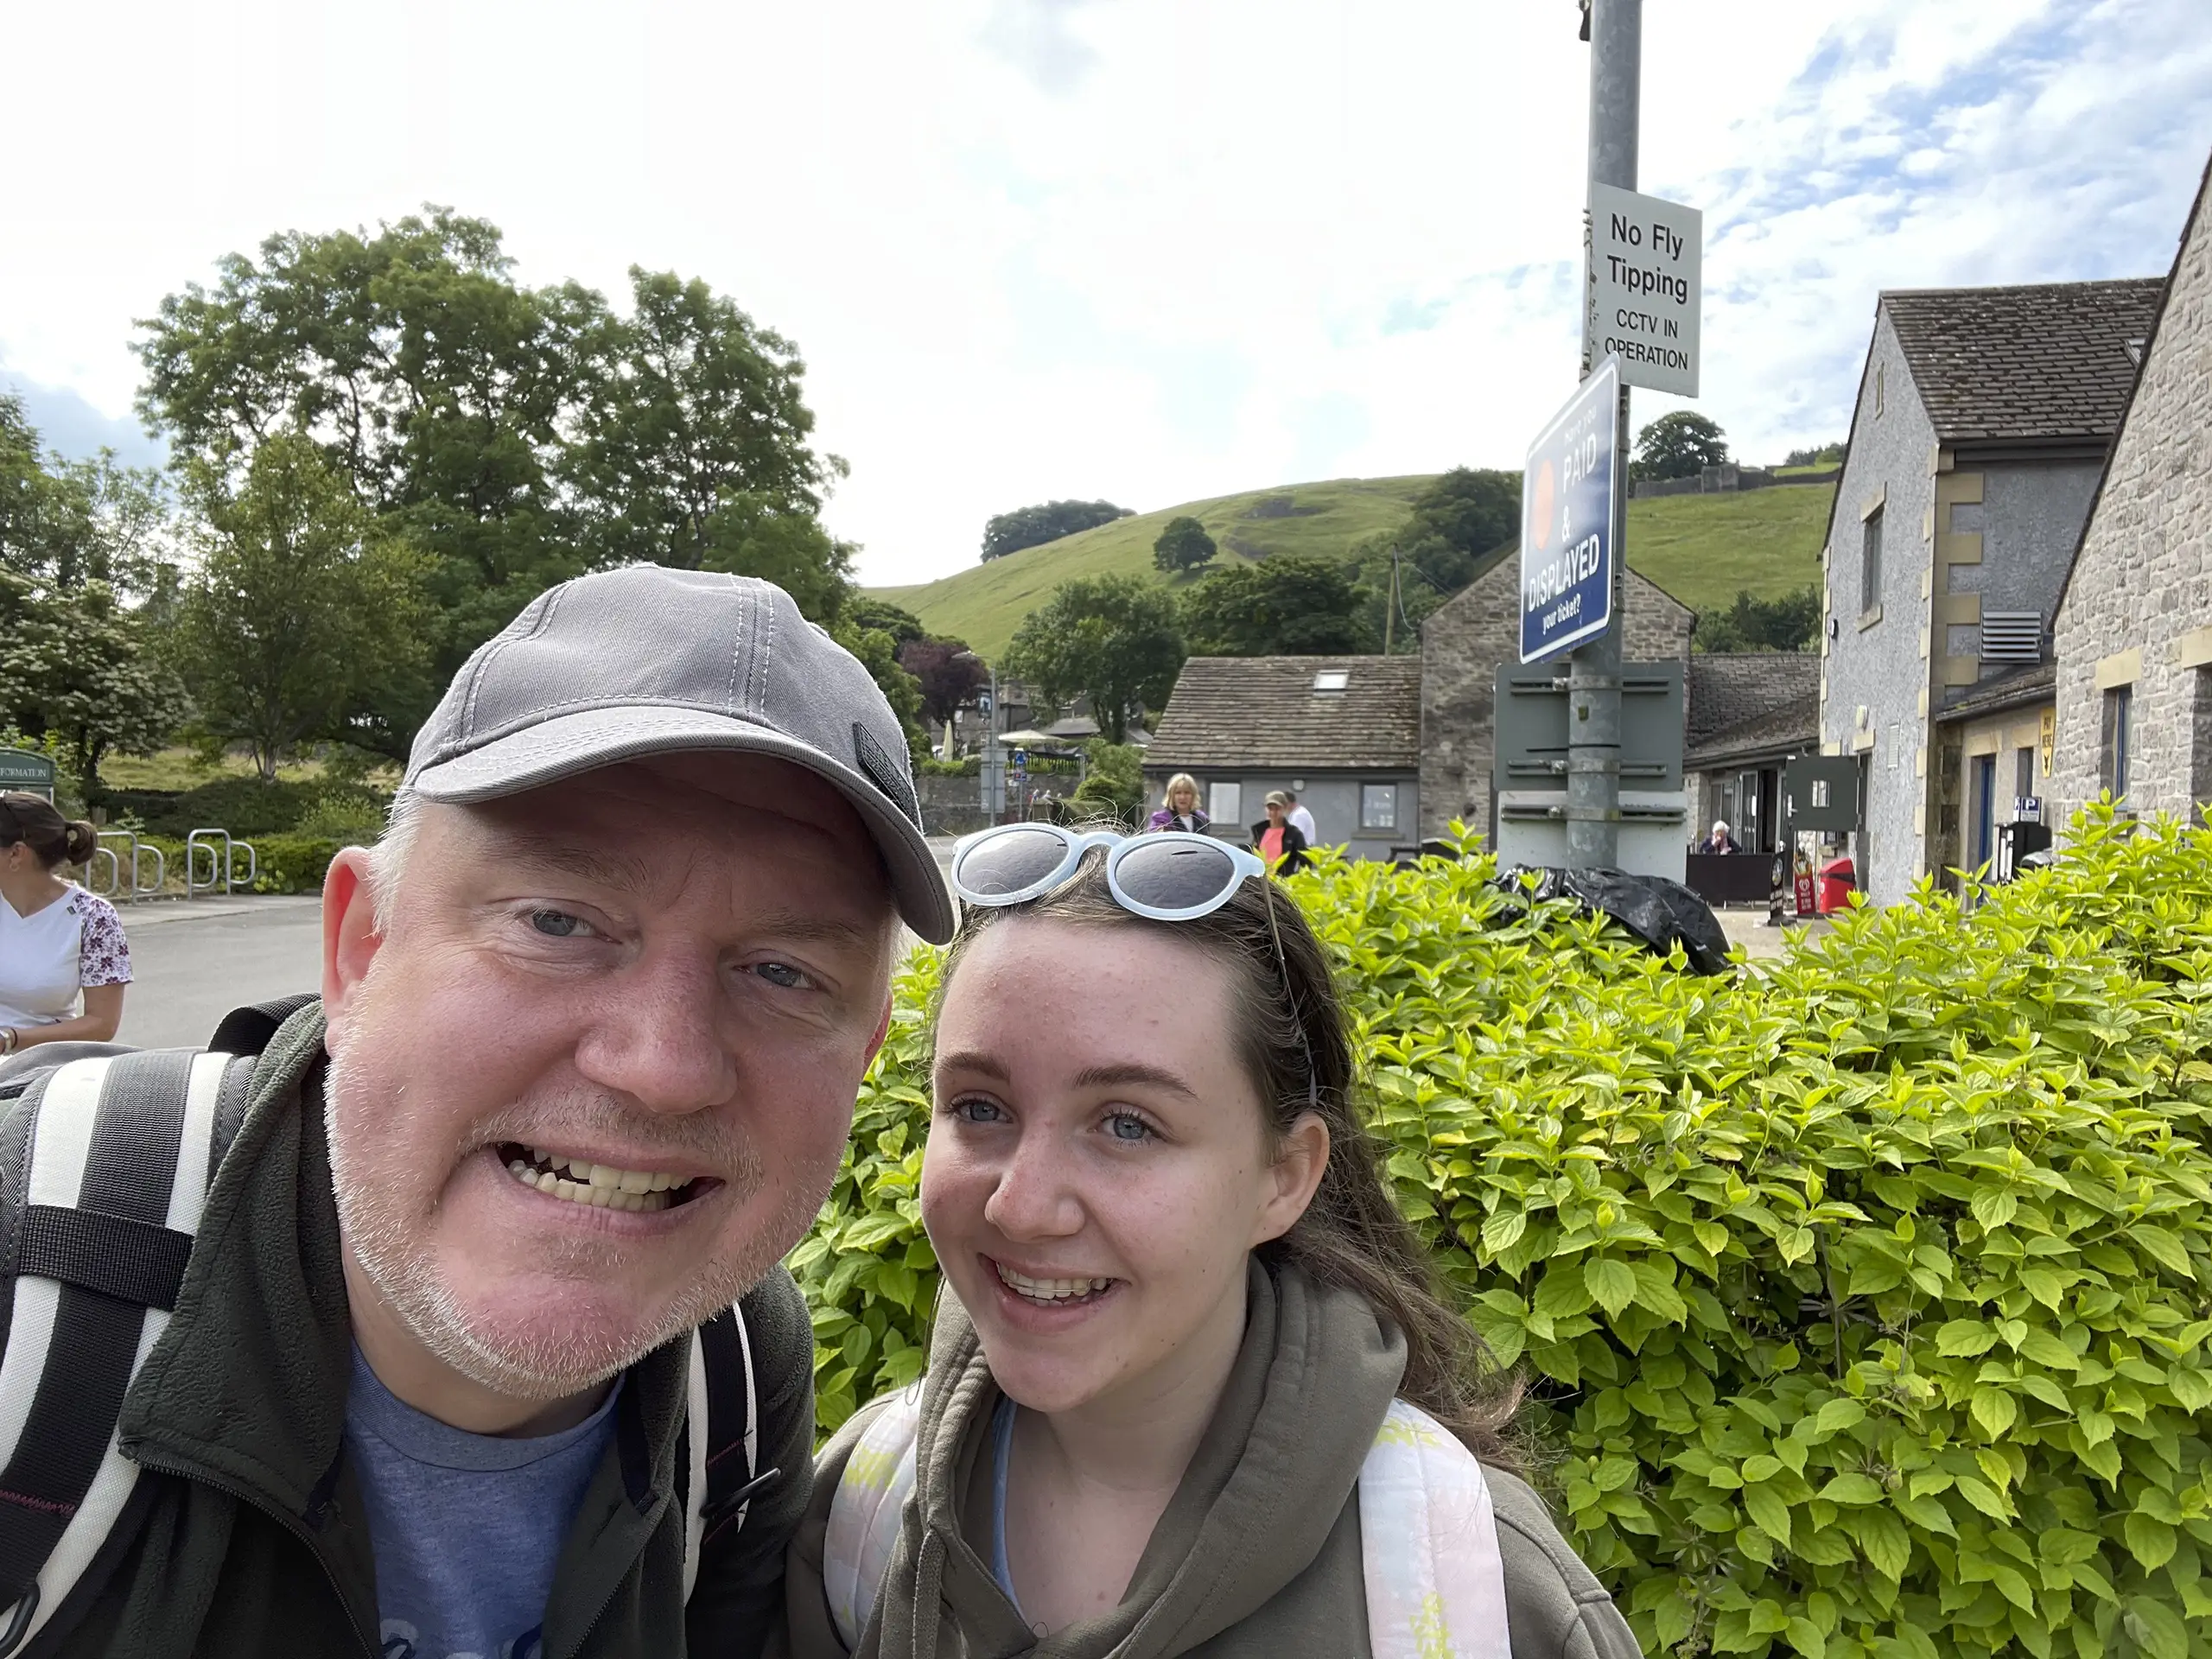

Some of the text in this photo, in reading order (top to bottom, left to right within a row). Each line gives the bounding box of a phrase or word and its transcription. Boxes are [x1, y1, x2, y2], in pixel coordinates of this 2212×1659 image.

[1611, 213, 1683, 261] No Fly
[1607, 254, 1688, 305] Tipping
[1616, 308, 1678, 339] CCTV IN
[1605, 337, 1688, 370] OPERATION
[1563, 433, 1597, 494] PAID
[1561, 505, 1570, 542] &
[1528, 533, 1599, 612] DISPLAYED
[1542, 593, 1581, 636] your ticket?
[2025, 799, 2036, 810] P
